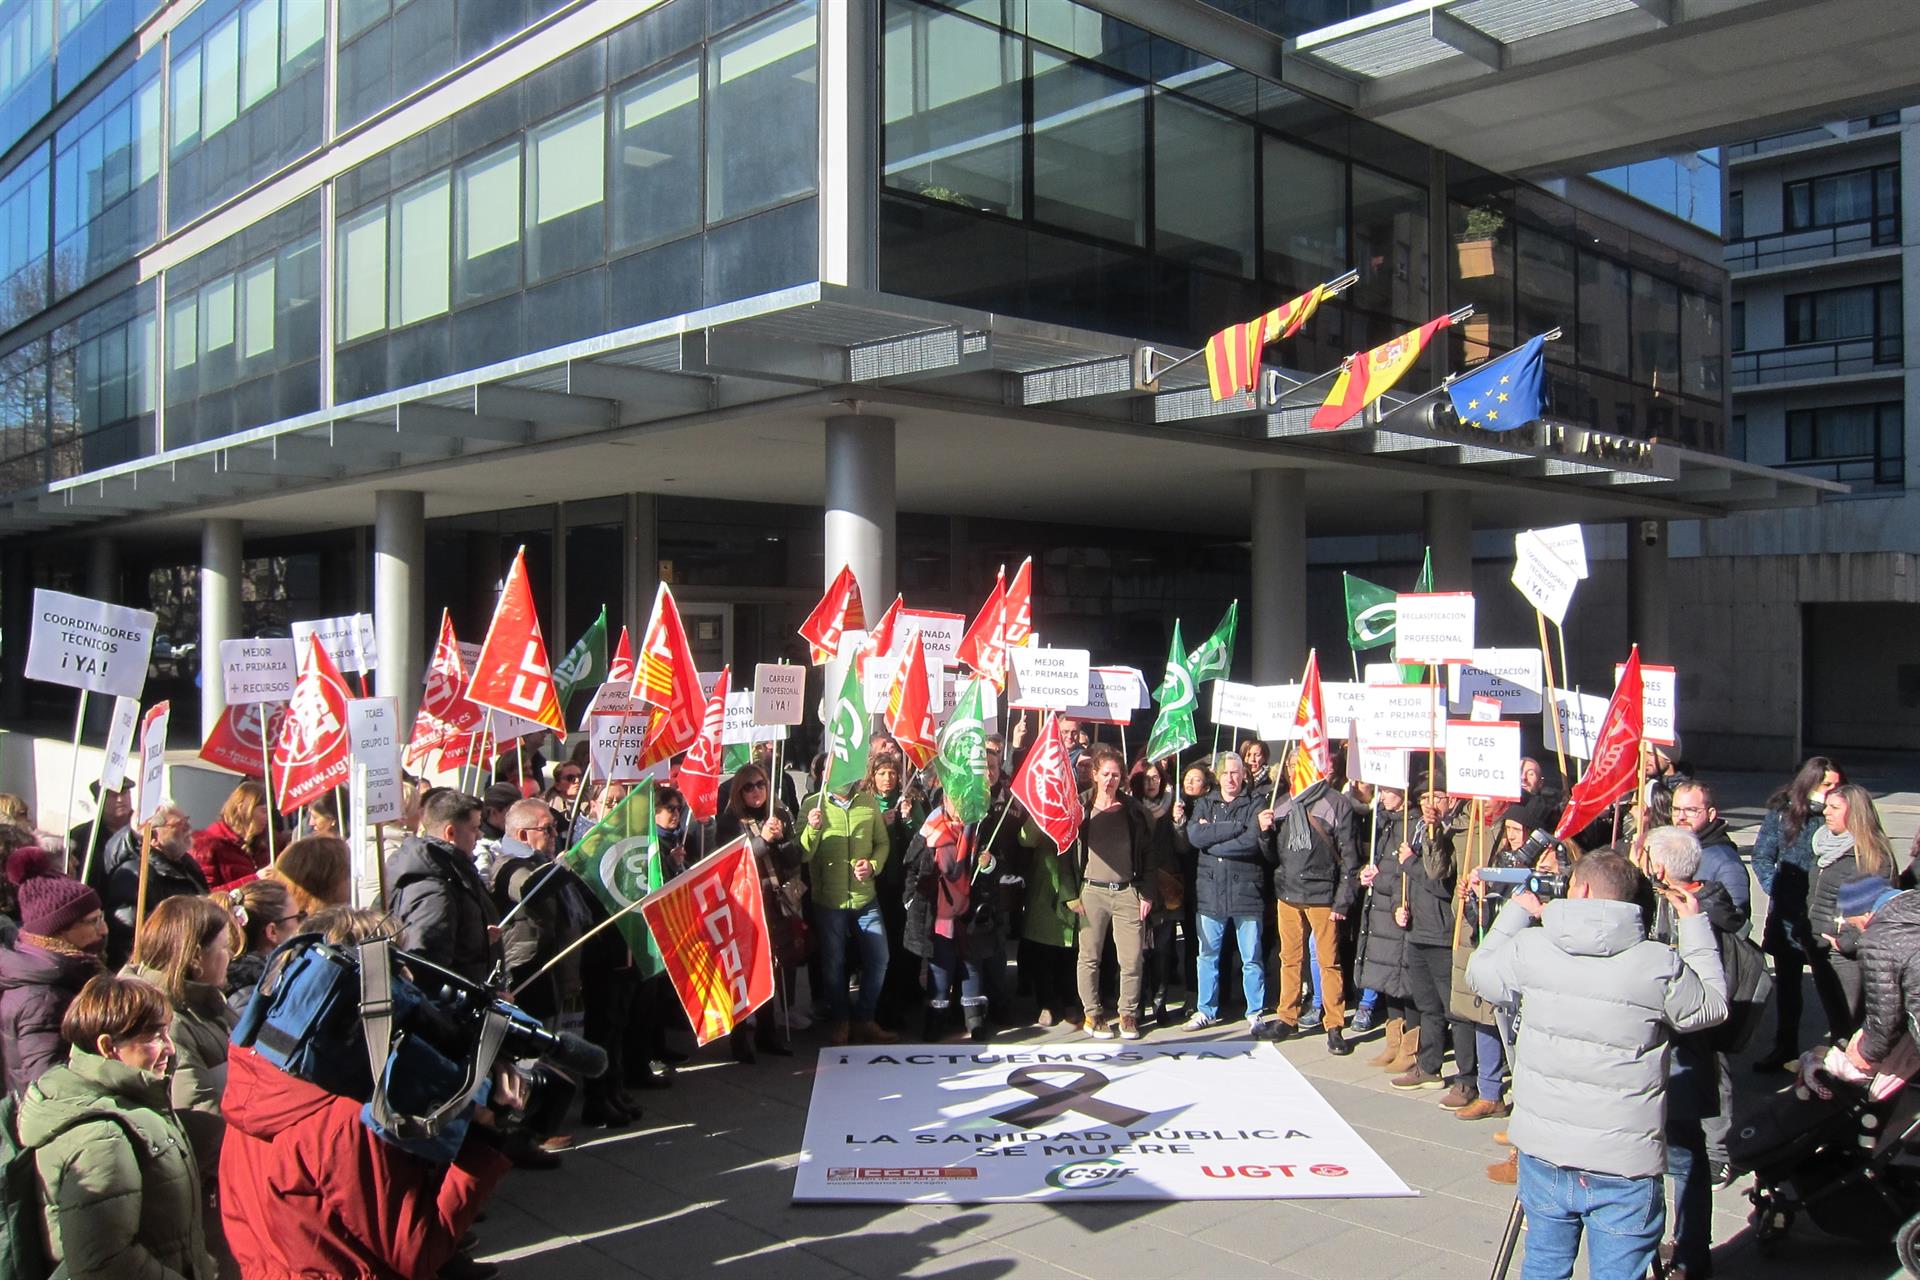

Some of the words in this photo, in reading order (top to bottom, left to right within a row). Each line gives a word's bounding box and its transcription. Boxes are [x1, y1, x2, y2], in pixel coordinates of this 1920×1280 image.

[43, 612, 142, 642] COORDINADORES
[61, 630, 118, 654] TÉCNICOS
[242, 647, 272, 658] MEJOR
[246, 662, 288, 672] PRIMARIA
[1034, 658, 1065, 667] MEJOR
[1035, 670, 1079, 679] PRIMARIA
[1461, 667, 1531, 677] ACTUALIZACIÓN
[768, 673, 796, 684] CARRERA
[1490, 678, 1503, 687] DE
[242, 682, 290, 694] RECURSOS
[762, 686, 800, 695] PROFESIONAL
[1030, 686, 1079, 697] RECURSOS
[1337, 692, 1366, 702] TCAES
[1388, 697, 1422, 707] MEJOR
[1348, 704, 1355, 712] A
[1390, 711, 1438, 720] PRIMARIA
[726, 721, 741, 730] 35
[1385, 730, 1439, 740] RECURSOS
[360, 737, 383, 750] GRUPO
[1466, 736, 1496, 748] TCAES
[1478, 753, 1484, 762] A
[1458, 767, 1491, 780] GRUPO
[692, 871, 751, 1016] CCOO
[867, 1050, 1144, 1066] ACTUEMOS
[845, 1133, 900, 1146] LA
[914, 1131, 1112, 1144] SANIDAD
[1127, 1127, 1313, 1141] PÚBLICA
[974, 1145, 1028, 1158] SE
[1043, 1143, 1195, 1157] MUERE
[1200, 1164, 1298, 1179] UGT
